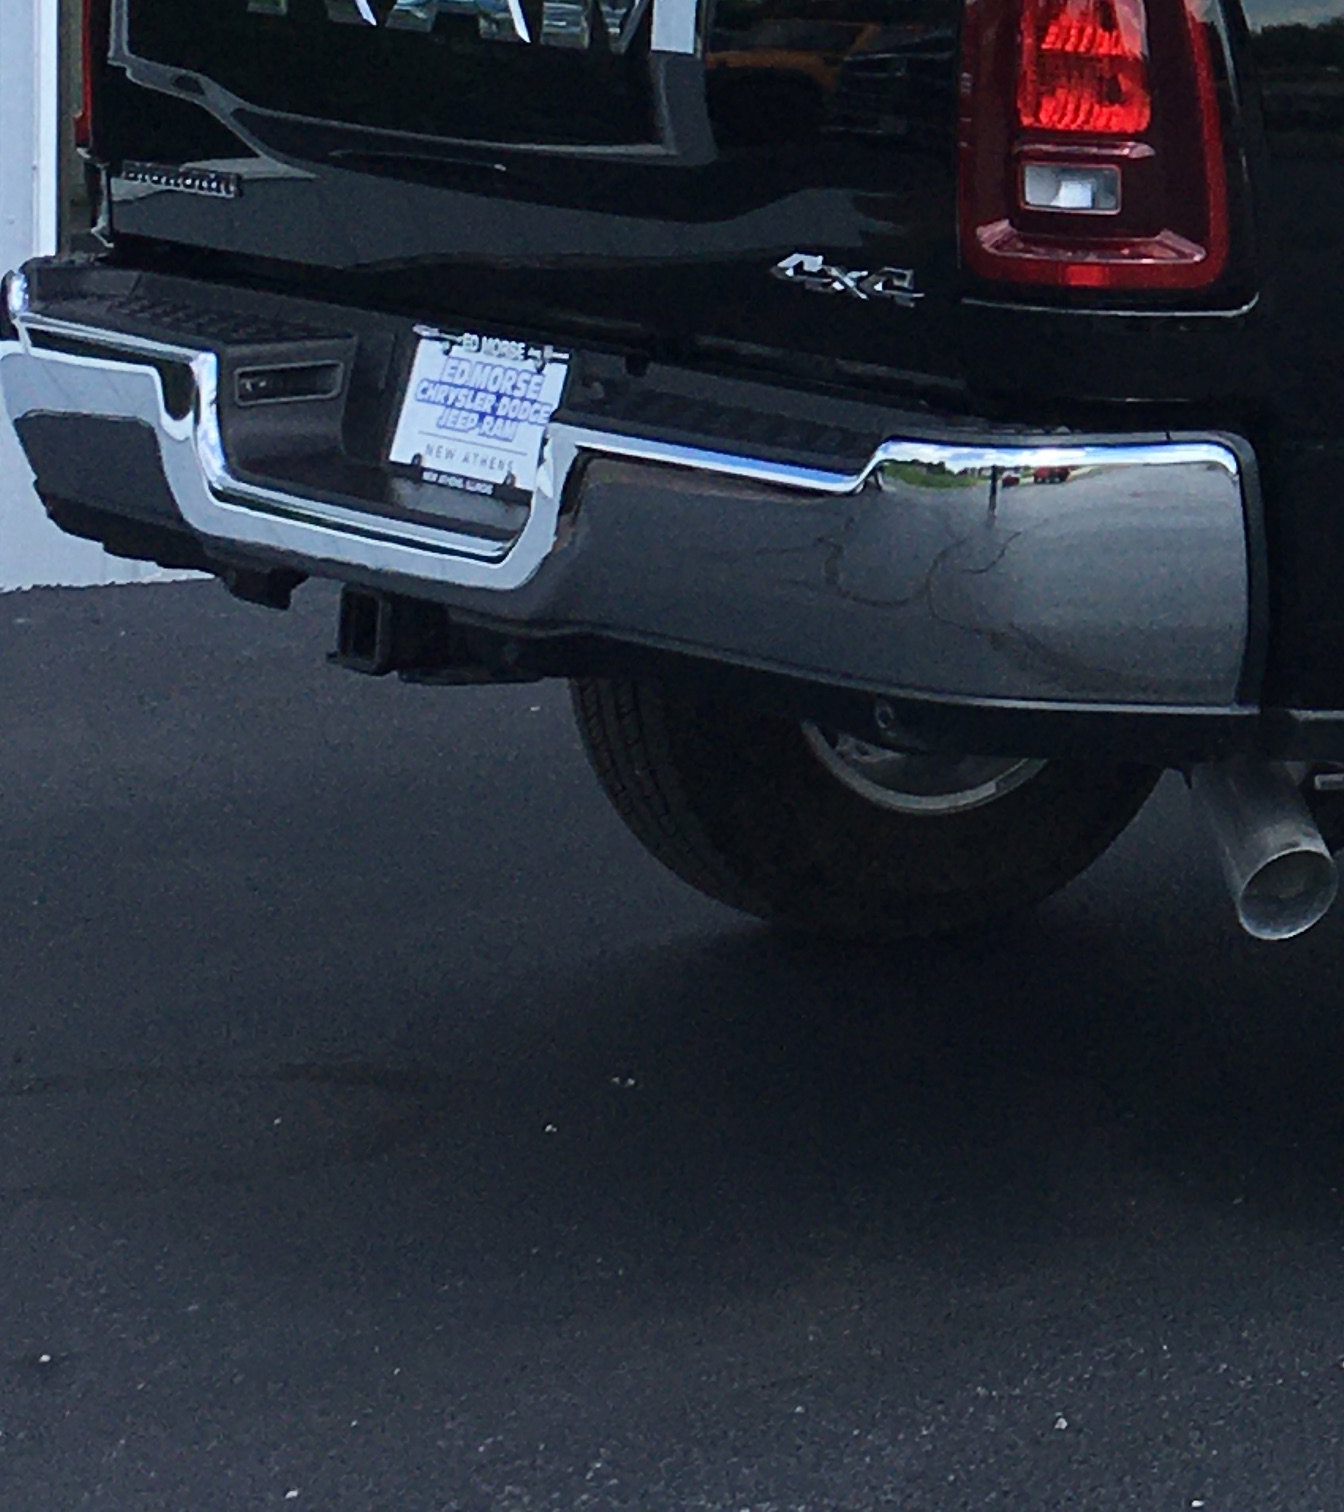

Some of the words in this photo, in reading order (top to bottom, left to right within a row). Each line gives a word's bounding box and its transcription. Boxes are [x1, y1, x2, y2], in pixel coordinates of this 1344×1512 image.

[441, 357, 472, 386] ED
[472, 362, 544, 400] MORSE
[425, 443, 456, 460] NEW
